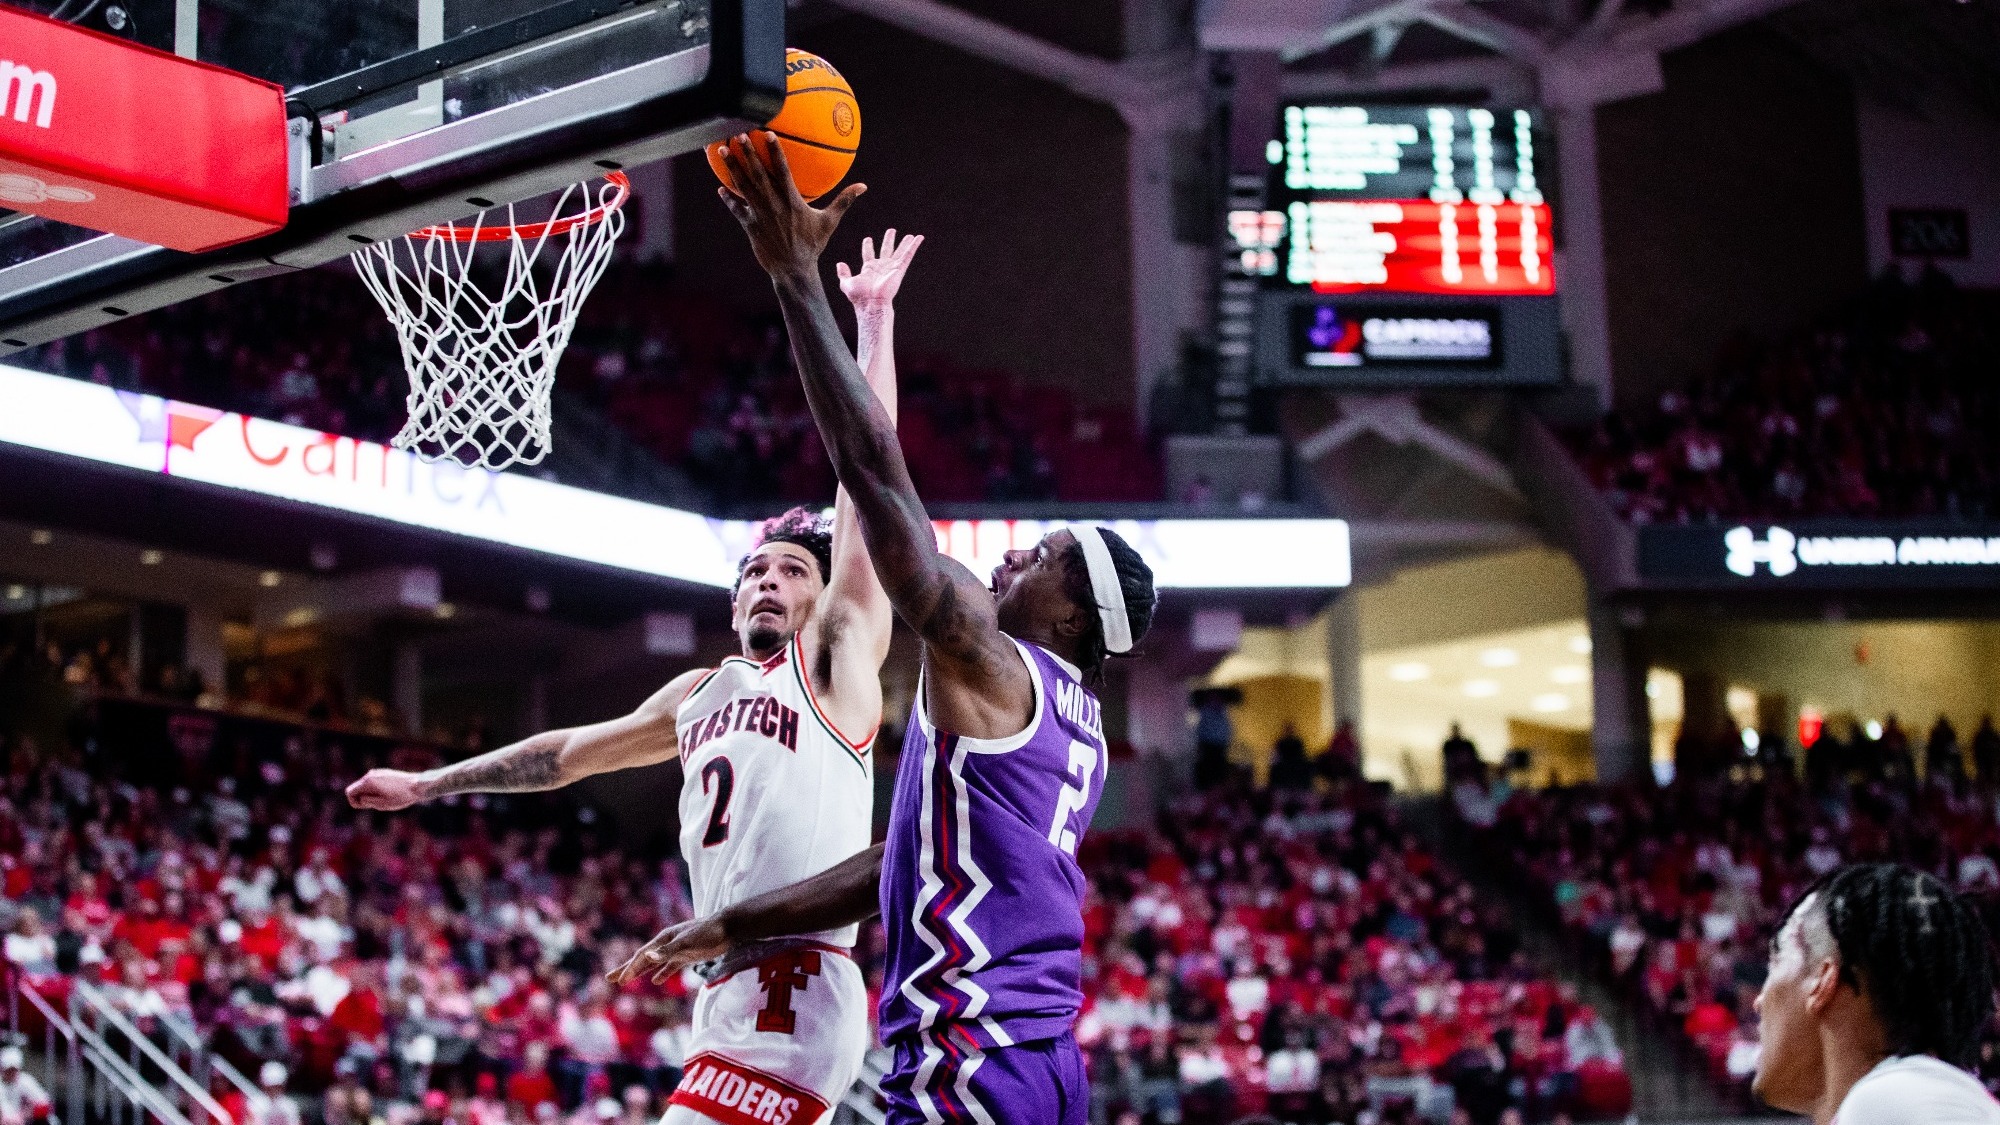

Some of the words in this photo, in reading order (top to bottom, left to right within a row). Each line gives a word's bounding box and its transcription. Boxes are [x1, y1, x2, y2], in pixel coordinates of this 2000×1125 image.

[1798, 536, 1896, 565] UNDER
[1897, 536, 2000, 565] ARMOU
[733, 696, 799, 754] TECH
[1056, 678, 1101, 741] MILLE
[701, 755, 735, 848] 2
[1048, 739, 1098, 857] 2
